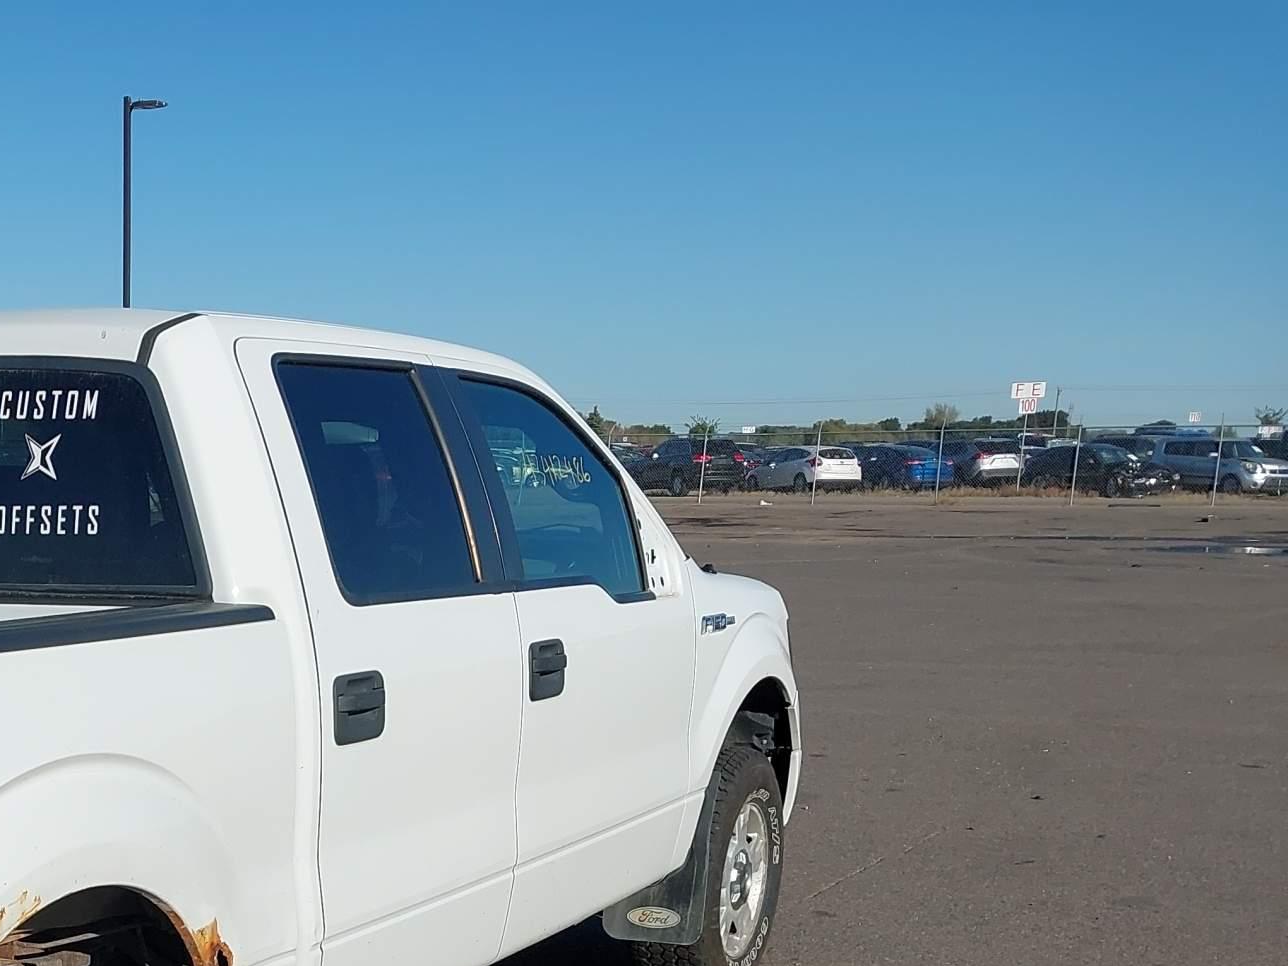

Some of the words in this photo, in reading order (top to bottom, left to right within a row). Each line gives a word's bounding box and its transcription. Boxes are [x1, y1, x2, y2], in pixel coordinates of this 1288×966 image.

[0, 390, 99, 420] CUSTOM
[1021, 399, 1036, 413] 100
[638, 910, 670, 925] Ford
